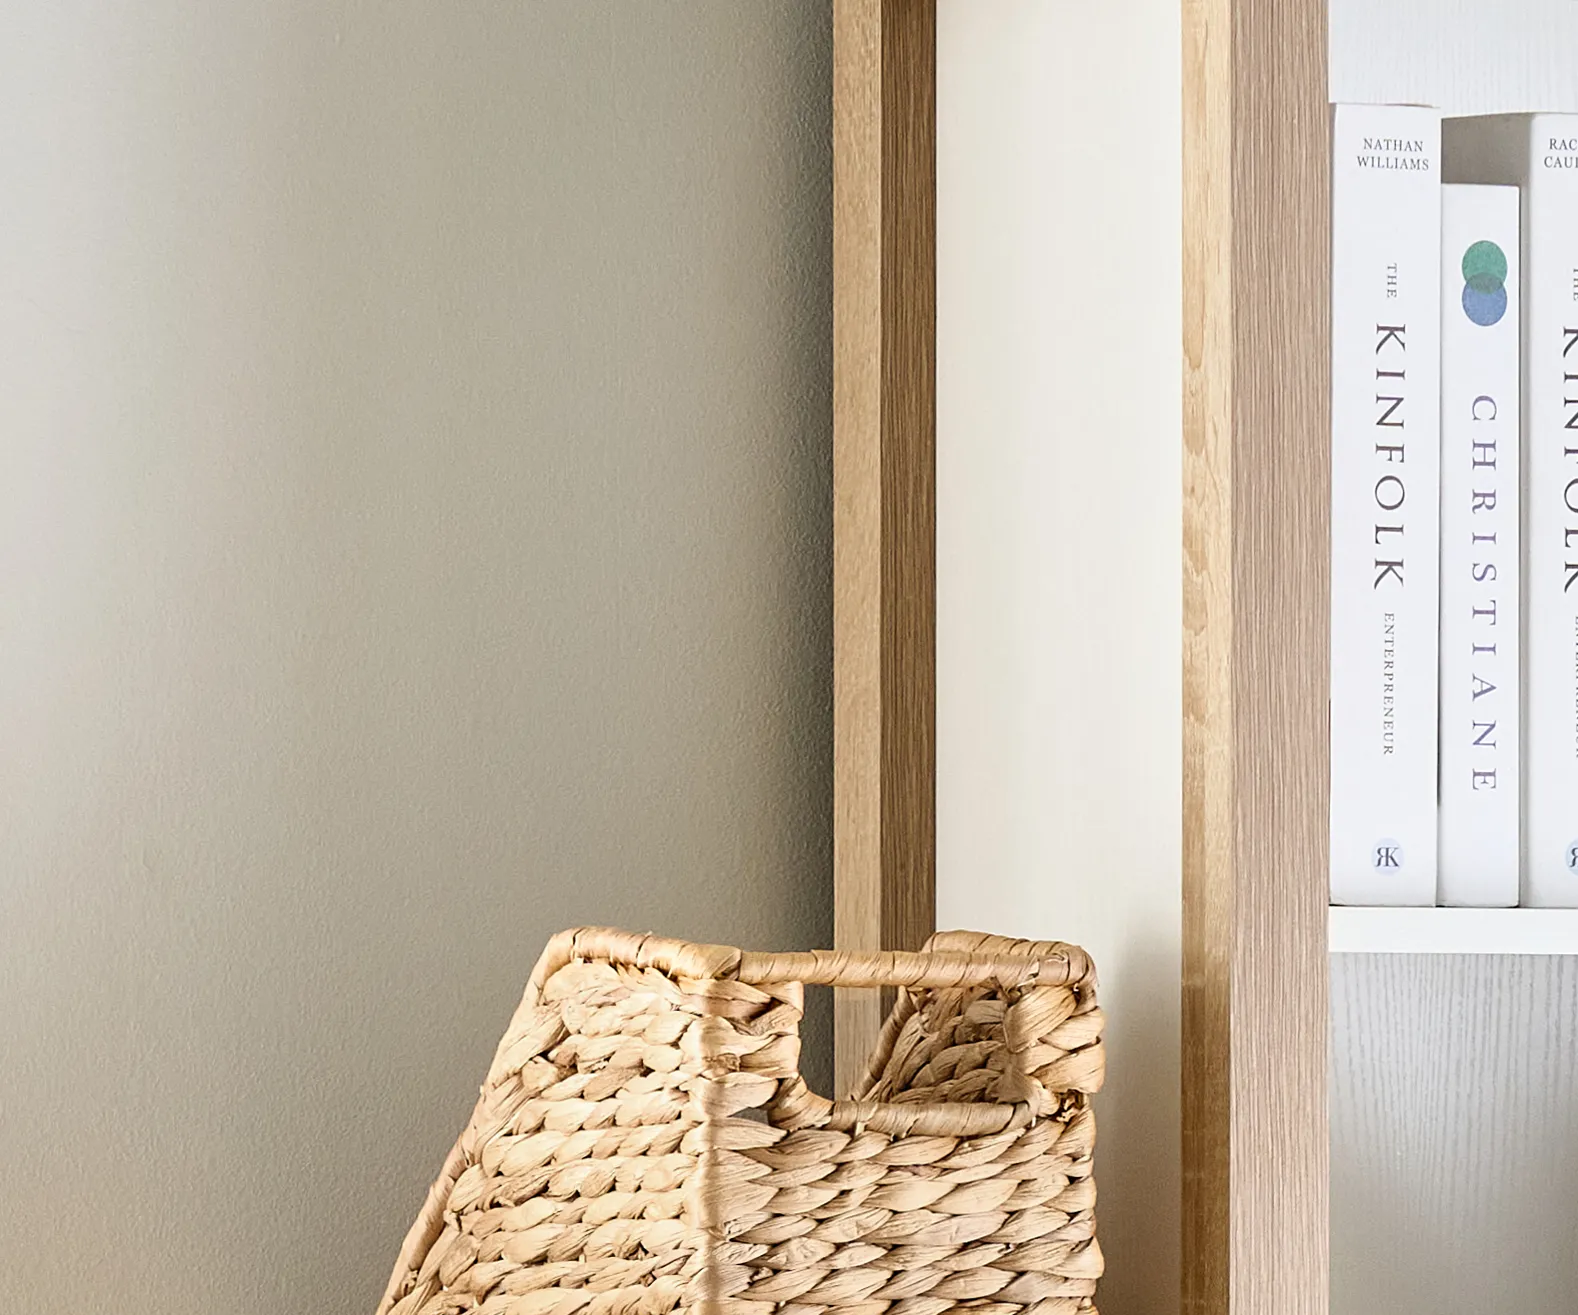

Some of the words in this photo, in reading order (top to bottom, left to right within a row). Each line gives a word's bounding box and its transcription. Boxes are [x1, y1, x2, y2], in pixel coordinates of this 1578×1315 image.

[1356, 156, 1429, 171] WILLIAMS
[1363, 138, 1424, 153] NATHAN
[1386, 262, 1398, 298] THE
[1374, 323, 1406, 590] KINFOLK
[1471, 395, 1498, 791] CHRISTIANE
[1383, 612, 1395, 755] ENTERPRENEUR
